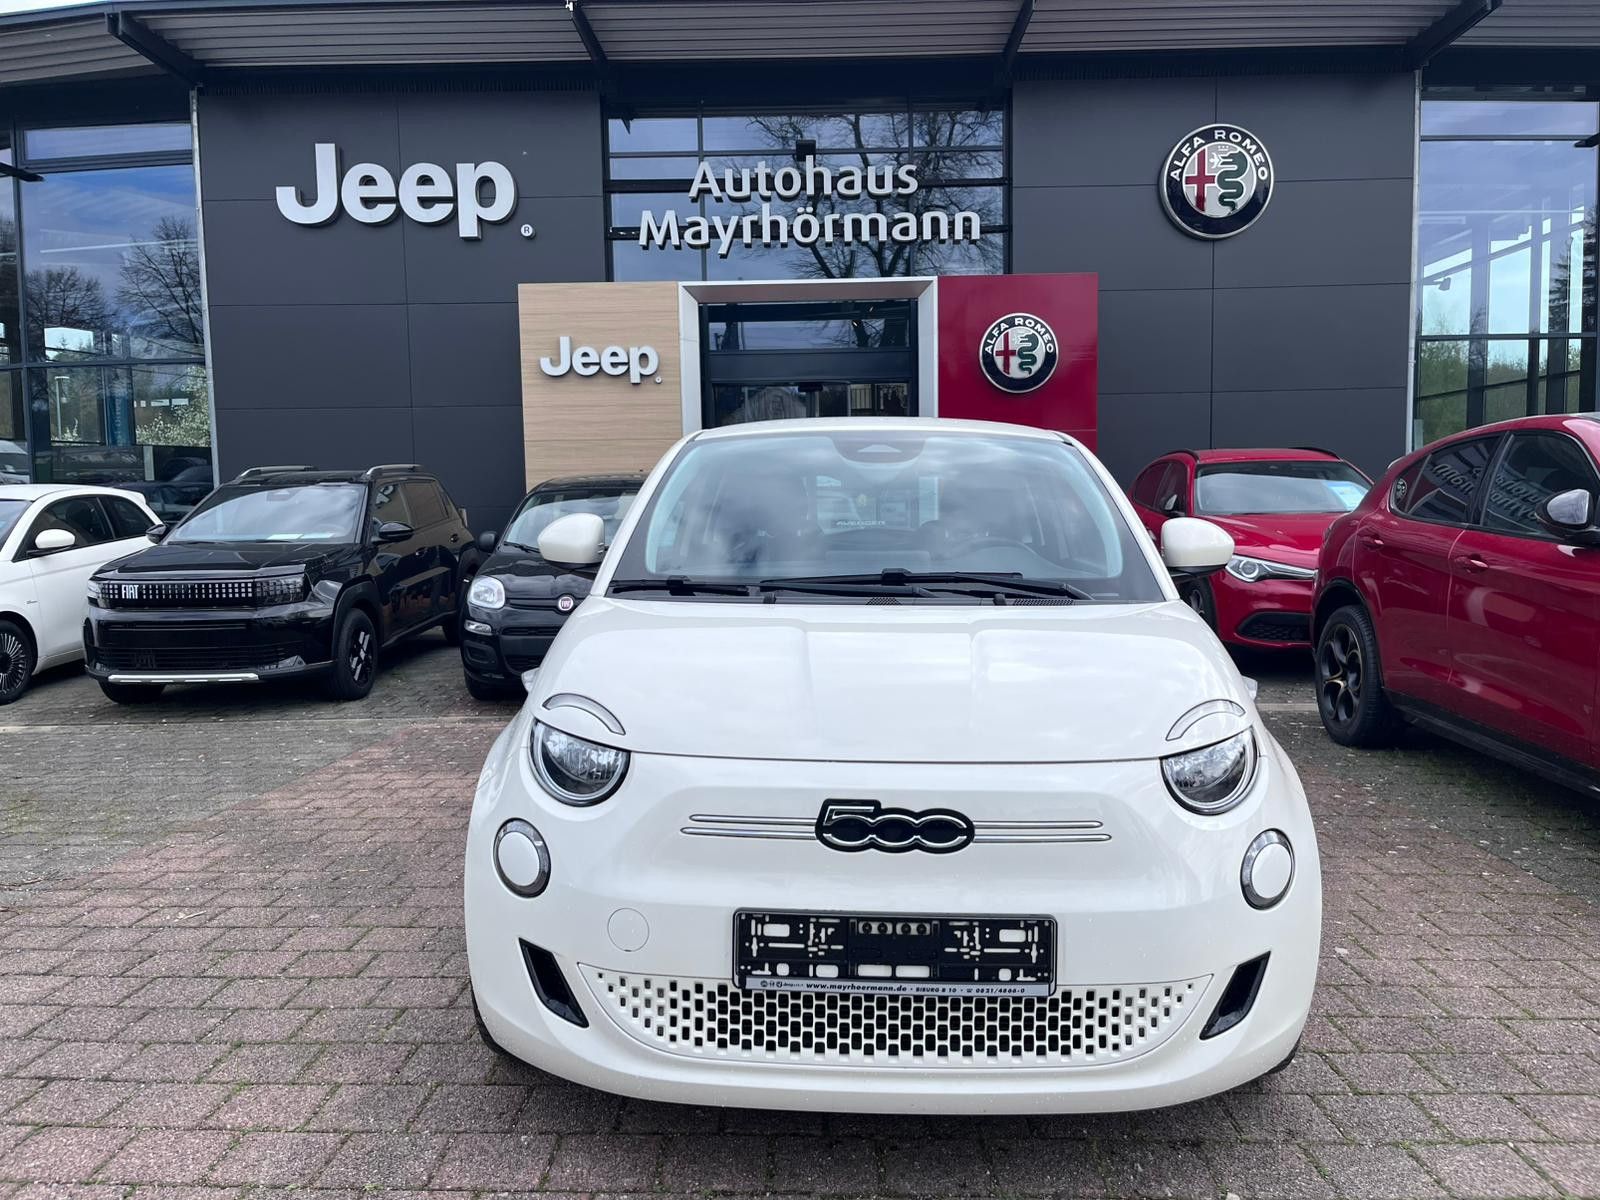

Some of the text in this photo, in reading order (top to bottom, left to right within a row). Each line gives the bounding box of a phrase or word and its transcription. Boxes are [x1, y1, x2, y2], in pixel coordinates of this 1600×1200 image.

[688, 155, 919, 200] Autohaus
[1170, 130, 1268, 181] ALFA ROMEO
[276, 142, 516, 239] Jeep
[638, 203, 981, 257] Mayrhörmann
[985, 317, 1054, 354] ALFA ROMEO
[540, 336, 659, 384] Jeep
[121, 584, 139, 600] FIAT
[822, 805, 968, 849] 500
[806, 982, 907, 992] www.mayrhoermann.de
